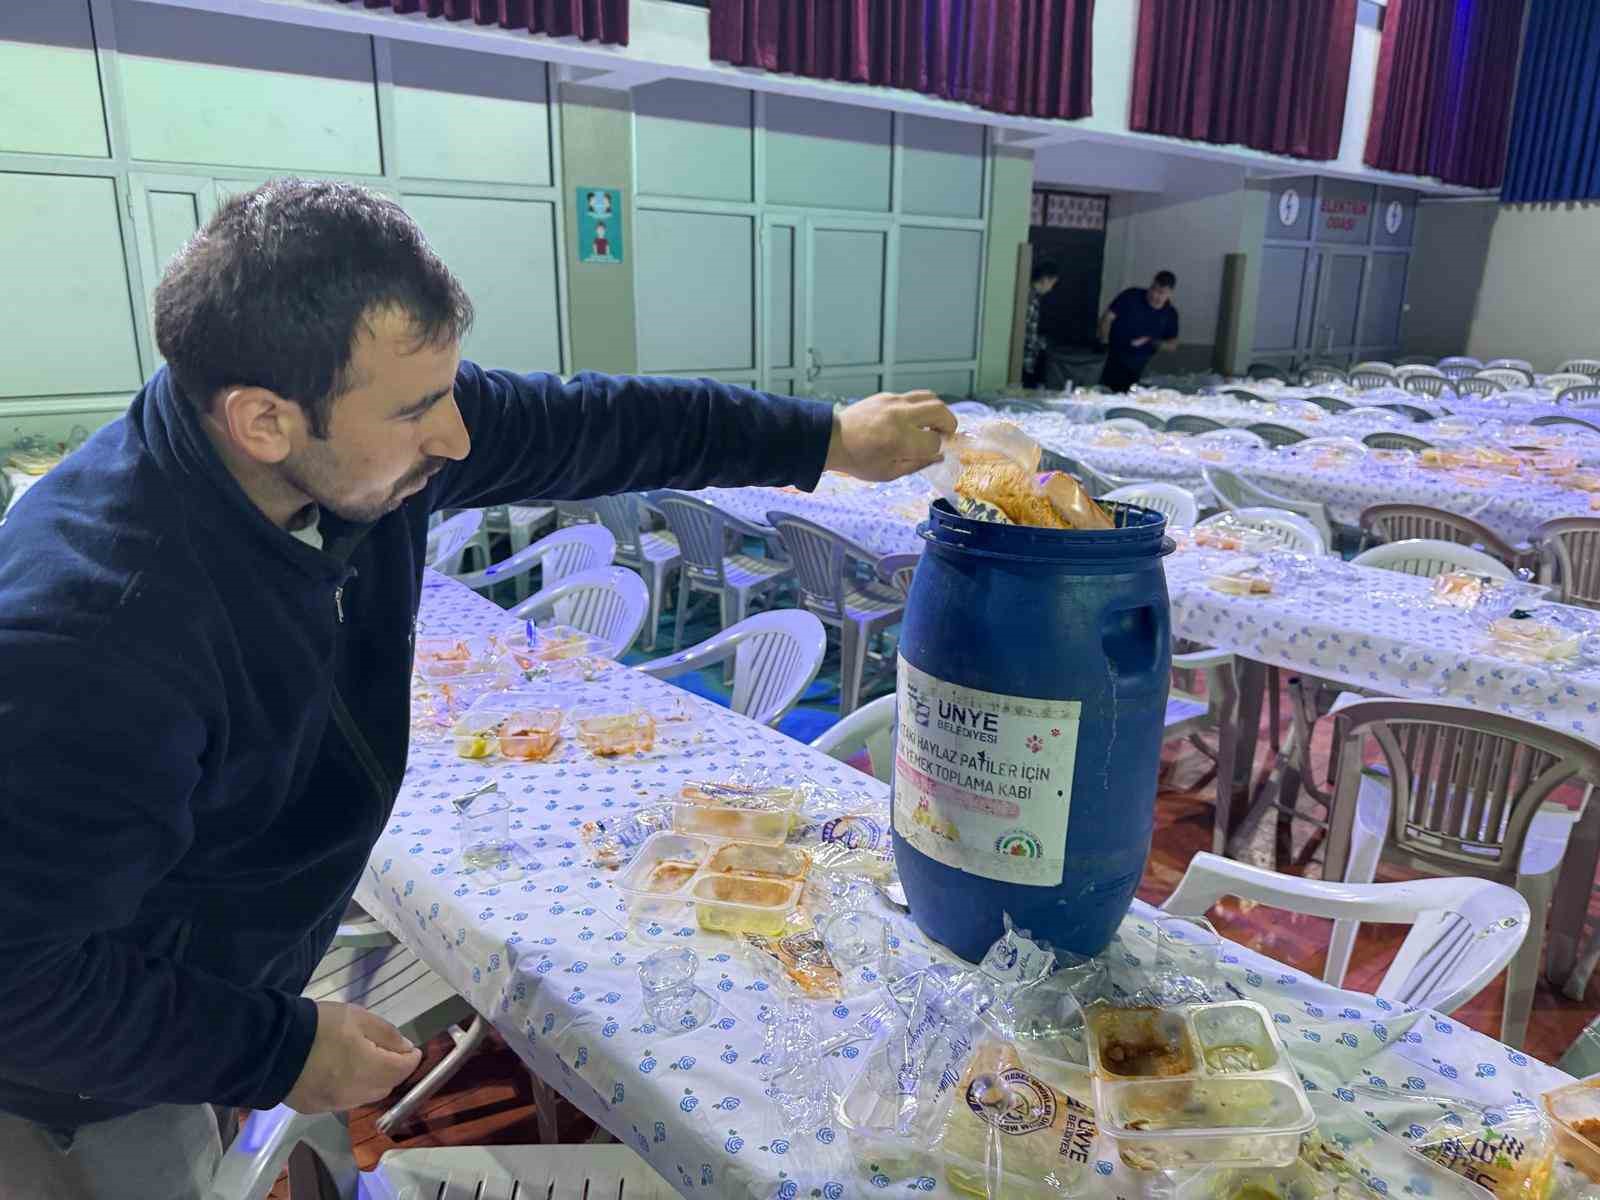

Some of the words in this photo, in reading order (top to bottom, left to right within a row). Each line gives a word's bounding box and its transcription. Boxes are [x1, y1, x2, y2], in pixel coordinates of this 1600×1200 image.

[918, 735, 958, 764] HAYLAZ
[1021, 761, 1051, 783] İÇİN
[935, 763, 994, 795] TOPLAMA
[999, 783, 1033, 800] KABI
